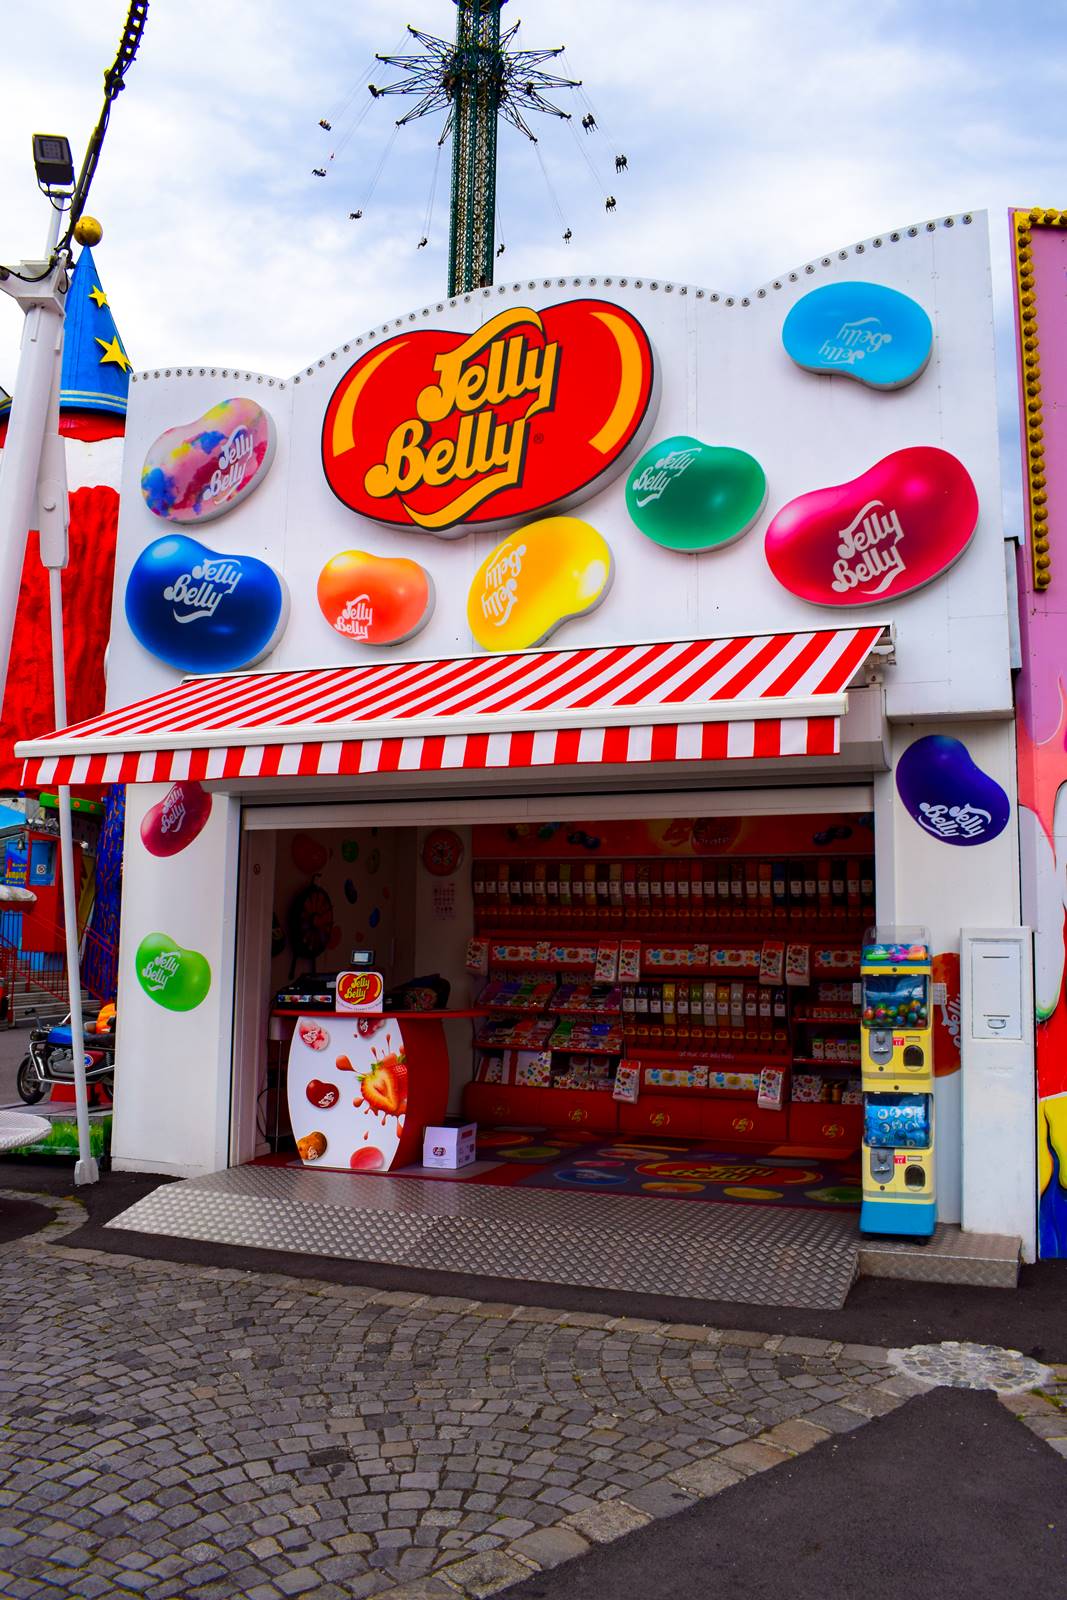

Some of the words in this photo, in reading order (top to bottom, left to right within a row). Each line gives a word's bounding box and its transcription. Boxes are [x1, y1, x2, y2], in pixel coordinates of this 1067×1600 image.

[818, 340, 865, 365] Jelly
[836, 317, 892, 353] Belly
[416, 307, 562, 422] Jelly
[219, 425, 254, 470] Jelly
[655, 447, 702, 478] Jelly
[202, 462, 247, 505] Belly
[364, 410, 532, 532] Belly
[632, 466, 672, 508] Belly
[837, 500, 905, 559] Jelly
[191, 558, 243, 594] Jelly
[486, 543, 527, 590] Belly
[831, 545, 907, 595] Belly
[163, 573, 223, 624] Belly
[342, 594, 373, 625] Jelly
[481, 578, 518, 626] Jelly
[333, 616, 369, 640] Belly
[162, 785, 184, 814] Jelly
[161, 802, 186, 833] Belly
[918, 802, 960, 837] Belly
[948, 803, 992, 838] Jelly
[142, 961, 168, 991] Belly
[154, 951, 181, 977] Jelly
[351, 972, 370, 990] Jelly
[344, 986, 366, 1005] Belly
